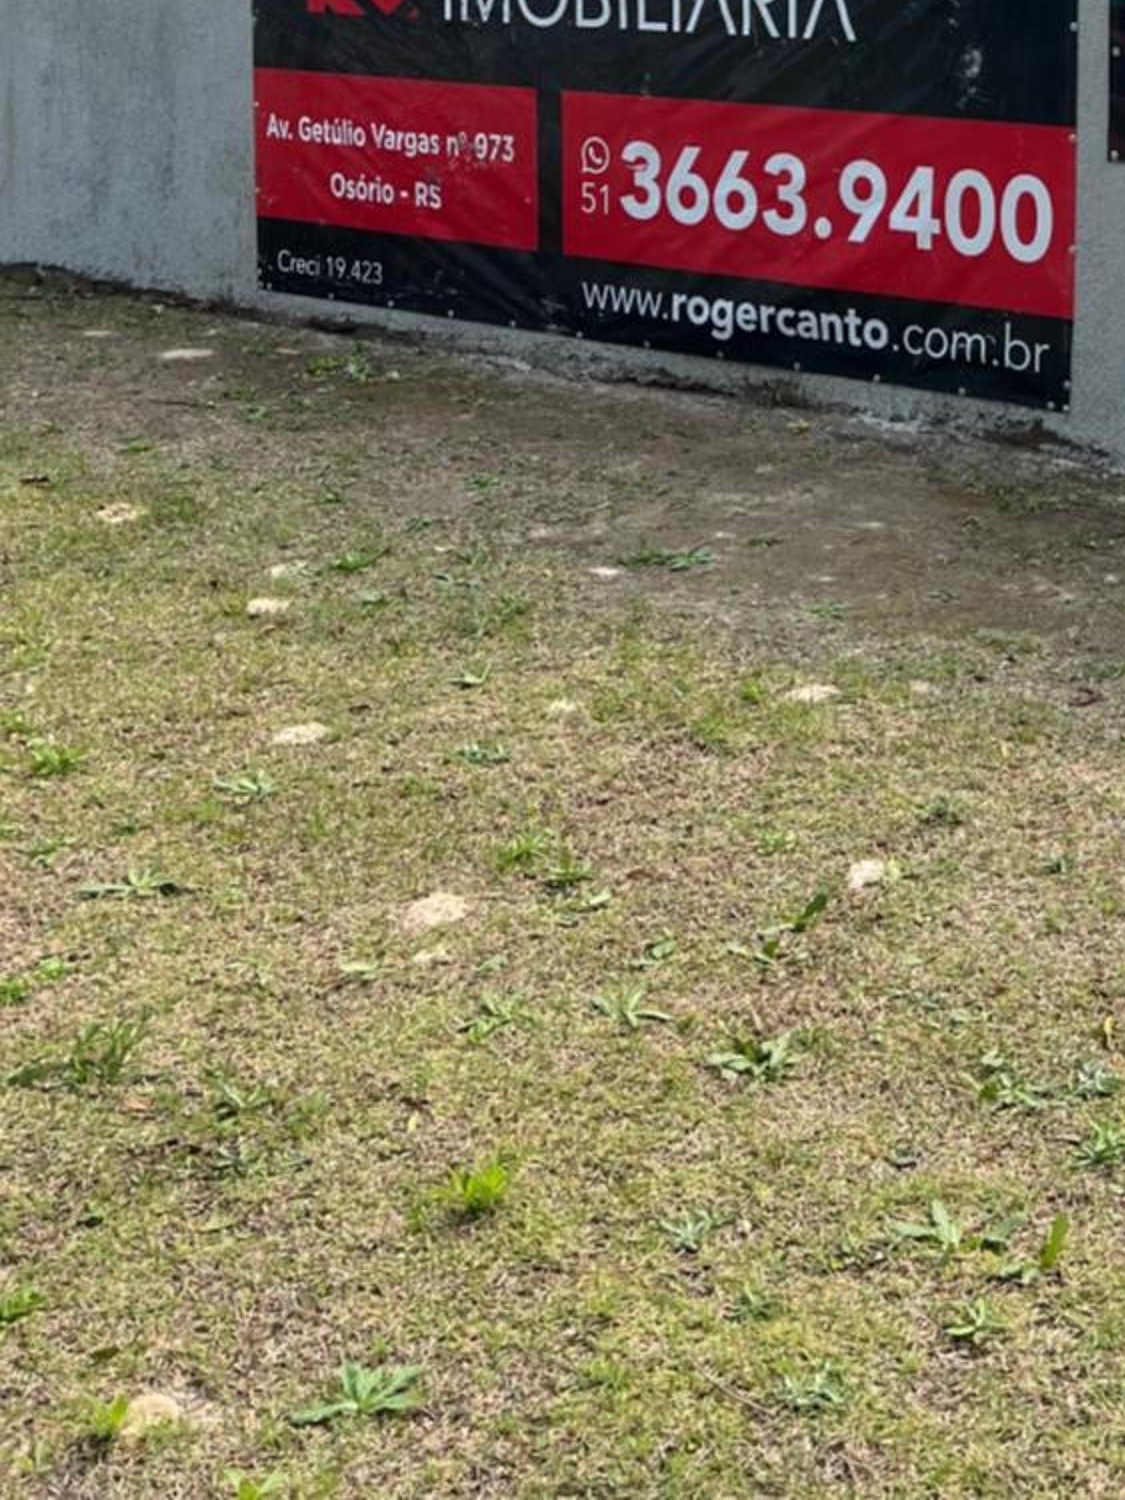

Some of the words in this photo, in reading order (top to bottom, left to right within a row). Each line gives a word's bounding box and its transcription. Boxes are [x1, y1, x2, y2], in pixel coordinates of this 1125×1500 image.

[266, 113, 293, 140] Av.
[298, 116, 367, 147] Getúlio
[371, 124, 440, 157] Vargas
[474, 133, 515, 162] 973
[330, 172, 395, 204] Osório
[415, 182, 442, 209] RS
[581, 183, 610, 215] 51
[620, 140, 1055, 264] 3663.9400
[276, 250, 321, 277] Creci
[327, 256, 384, 285] 19.423
[582, 282, 1050, 374] www.rogercanto.com.br
